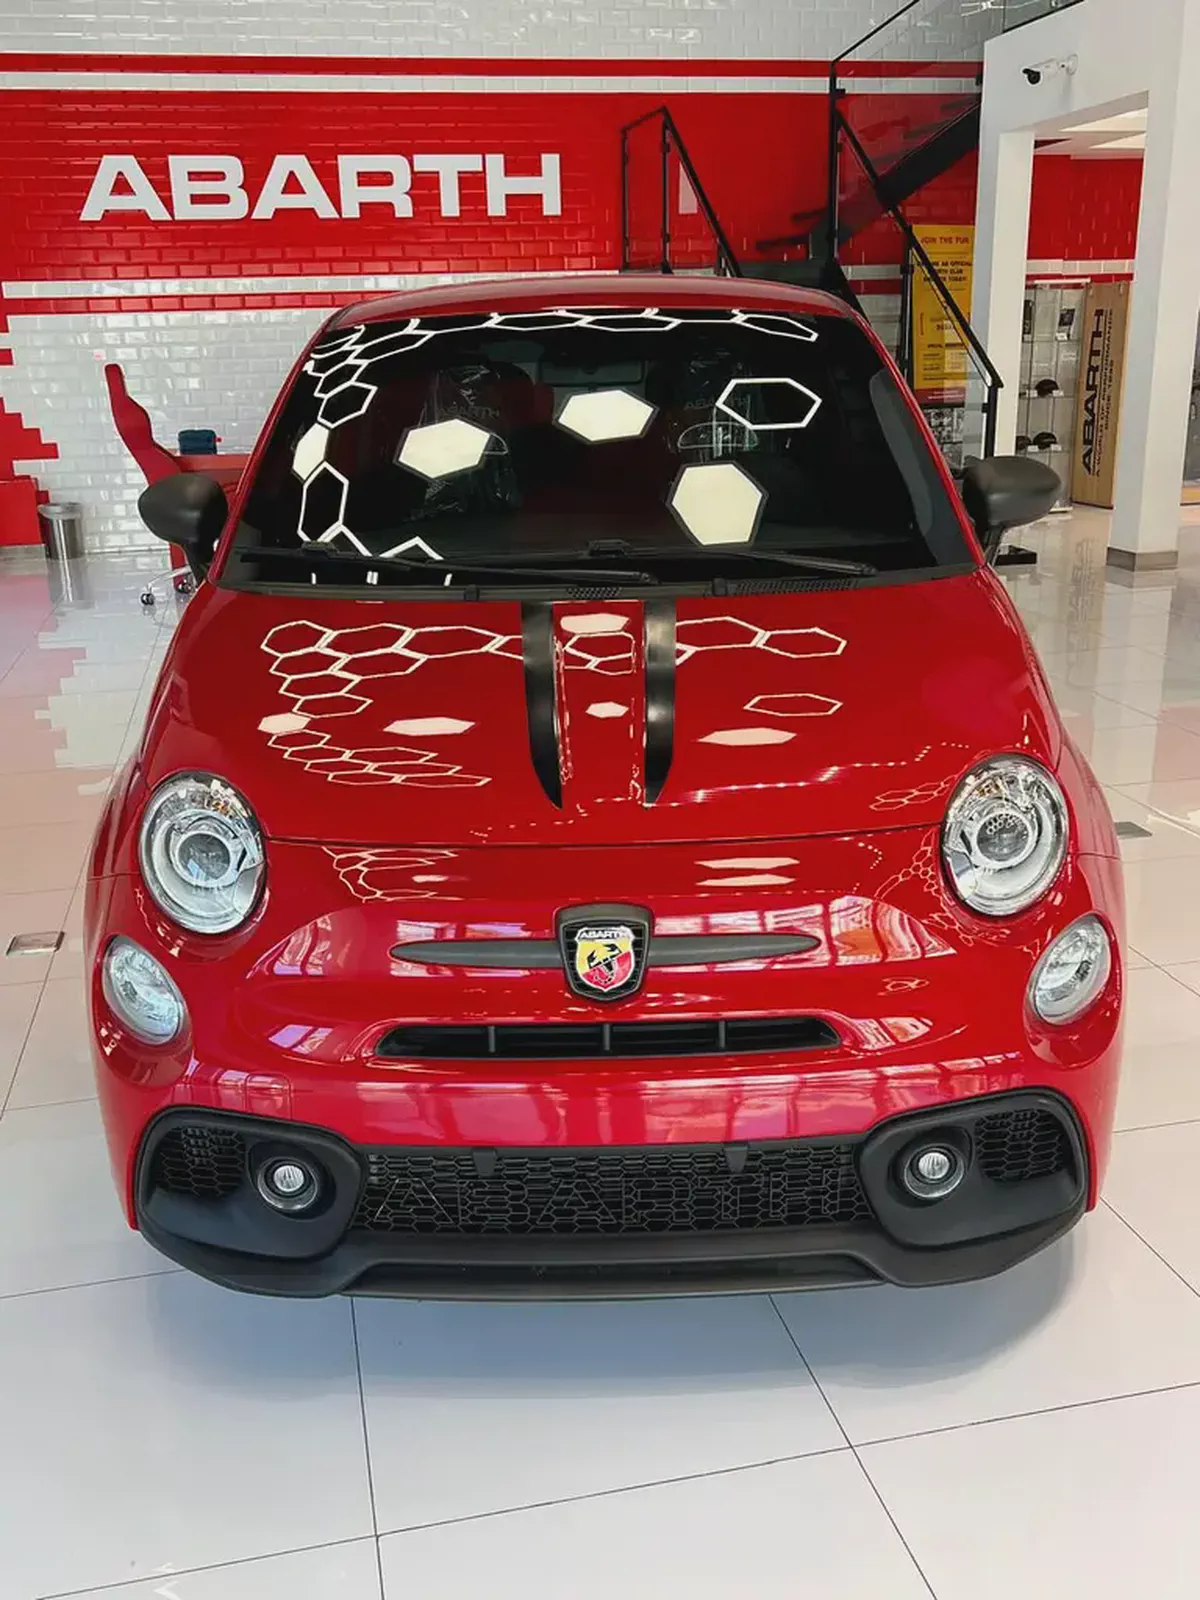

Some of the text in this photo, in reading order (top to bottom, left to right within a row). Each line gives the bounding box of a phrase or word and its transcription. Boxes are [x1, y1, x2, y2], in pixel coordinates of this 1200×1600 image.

[79, 153, 562, 221] ABARTH
[1082, 309, 1104, 475] ABARTH
[580, 930, 630, 940] ABARTH
[372, 1167, 841, 1225] ABARTH
